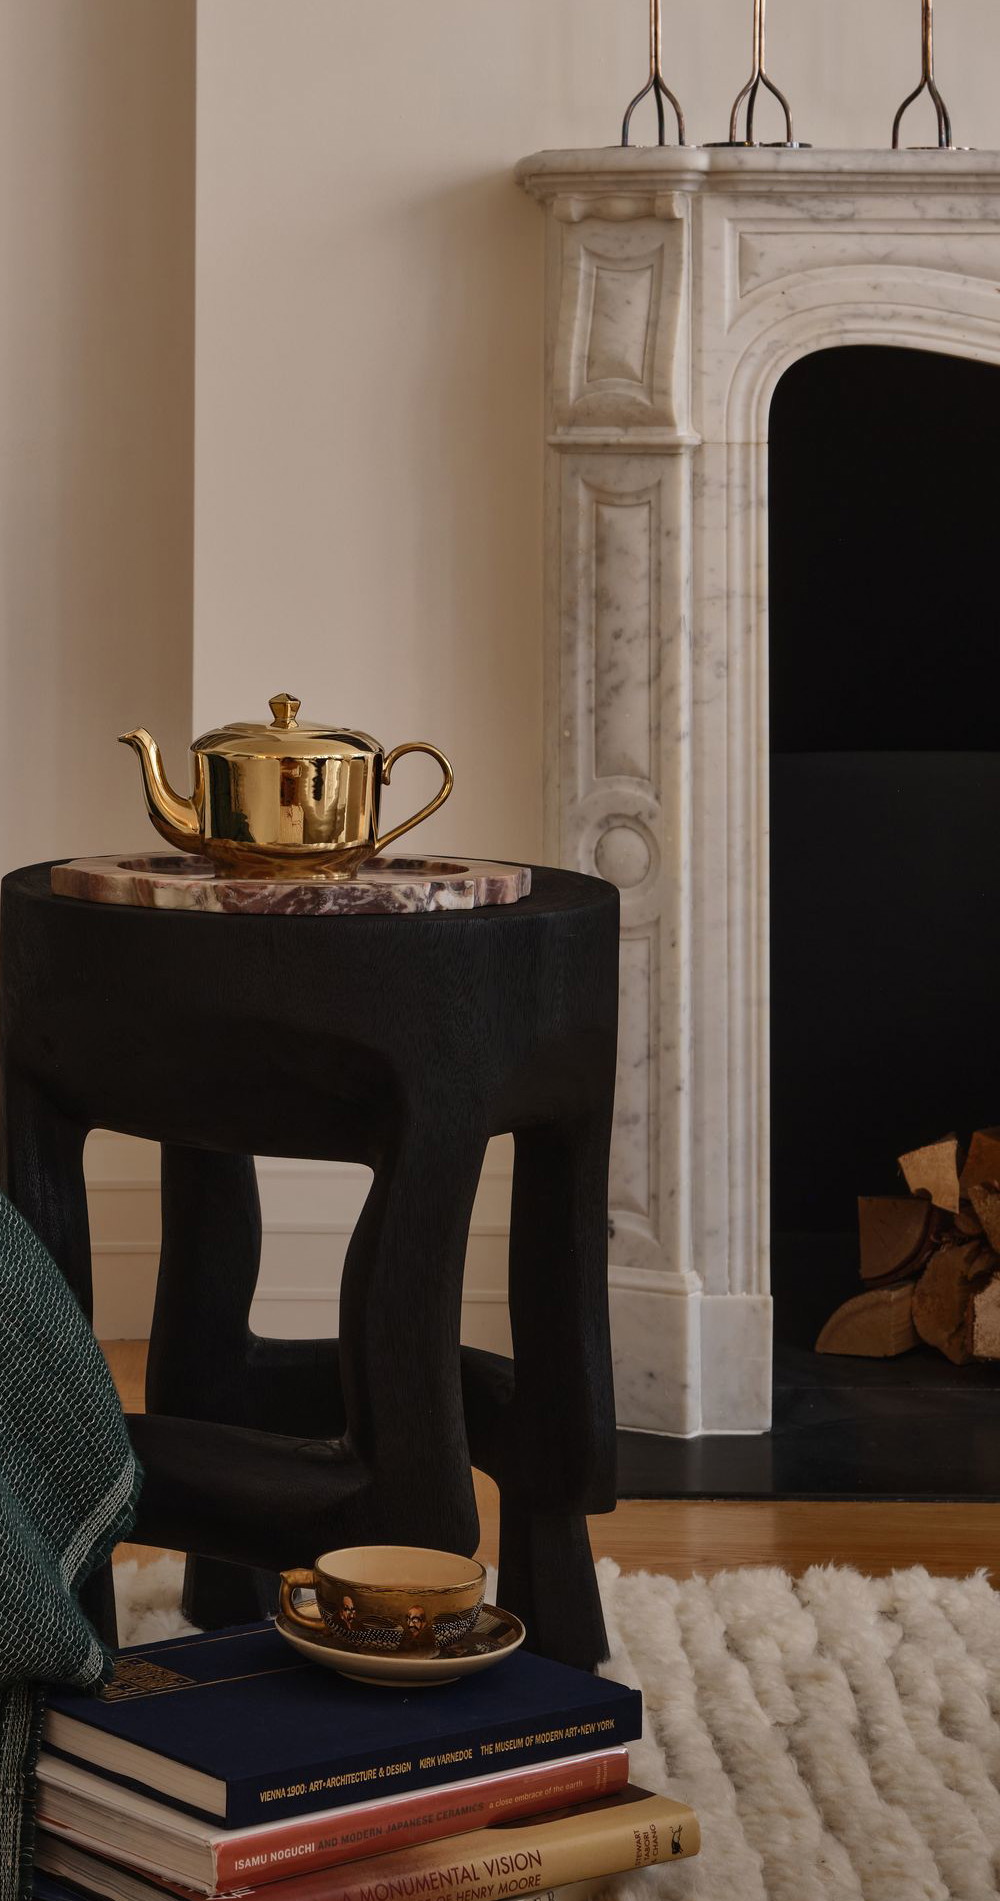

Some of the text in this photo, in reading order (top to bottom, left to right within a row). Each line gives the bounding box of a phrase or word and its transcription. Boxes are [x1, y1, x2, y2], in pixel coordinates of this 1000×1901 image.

[260, 1788, 286, 1803] VIENNA
[287, 1784, 307, 1797] 1900:
[379, 1767, 385, 1777] &
[386, 1762, 412, 1776] DESIGN
[420, 1756, 436, 1769] KIRK
[436, 1749, 473, 1766] VARNEDOE
[480, 1743, 494, 1756] THE
[495, 1738, 524, 1754] MUSEUM
[525, 1736, 534, 1747] OF
[535, 1729, 564, 1745] MODERN
[597, 1719, 615, 1733] YORK
[495, 1796, 513, 1808] close
[514, 1790, 543, 1804] embrace
[544, 1787, 553, 1796] of
[554, 1785, 563, 1794] the
[564, 1780, 583, 1792] earth
[235, 1802, 485, 1871] ISAMU NOGUCHI AND MODERN JAPANESE CERAMICS
[634, 1830, 642, 1866] STEWART
[650, 1823, 658, 1856] CHANG
[359, 1864, 480, 1901] MONUMENTAL
[483, 1849, 543, 1877] VISION
[456, 1884, 495, 1901] HENRY
[498, 1874, 541, 1893] MOORE
